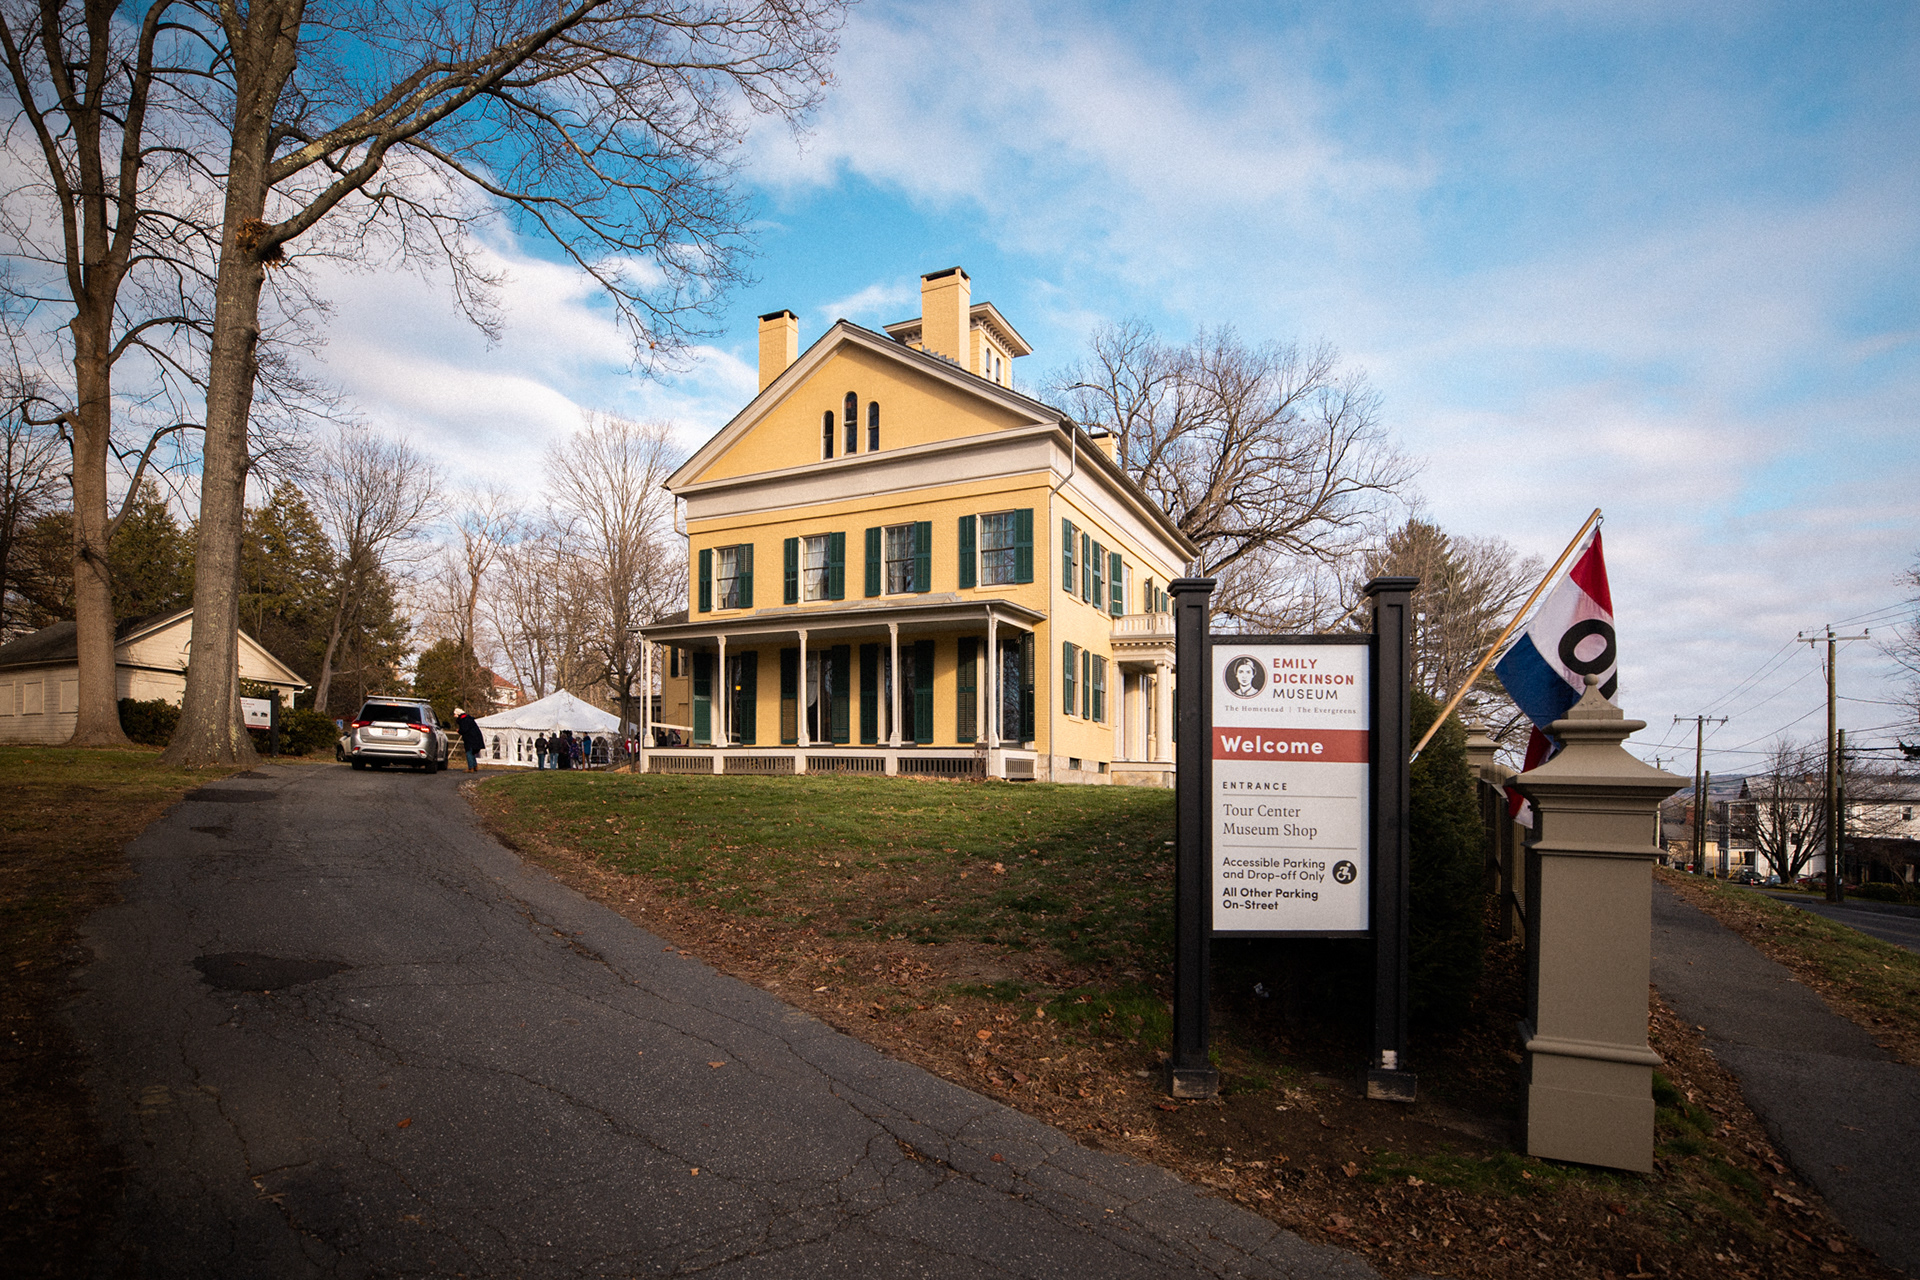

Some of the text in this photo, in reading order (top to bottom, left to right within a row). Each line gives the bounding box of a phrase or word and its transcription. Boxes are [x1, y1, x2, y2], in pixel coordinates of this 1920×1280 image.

[1273, 658, 1317, 669] EMILY
[1273, 674, 1354, 685] DICKINSON
[1273, 689, 1337, 699] MUSEUM
[1221, 736, 1323, 754] Welcome
[1223, 782, 1287, 790] ENTRANCE
[1223, 804, 1301, 817] Tour Center
[1223, 823, 1317, 839] Museum Shop
[1223, 857, 1325, 871] Accessible Parking
[1223, 870, 1325, 883] and Drop-off Only
[1223, 888, 1318, 901] All Other Parking
[1223, 900, 1278, 910] On-Street
